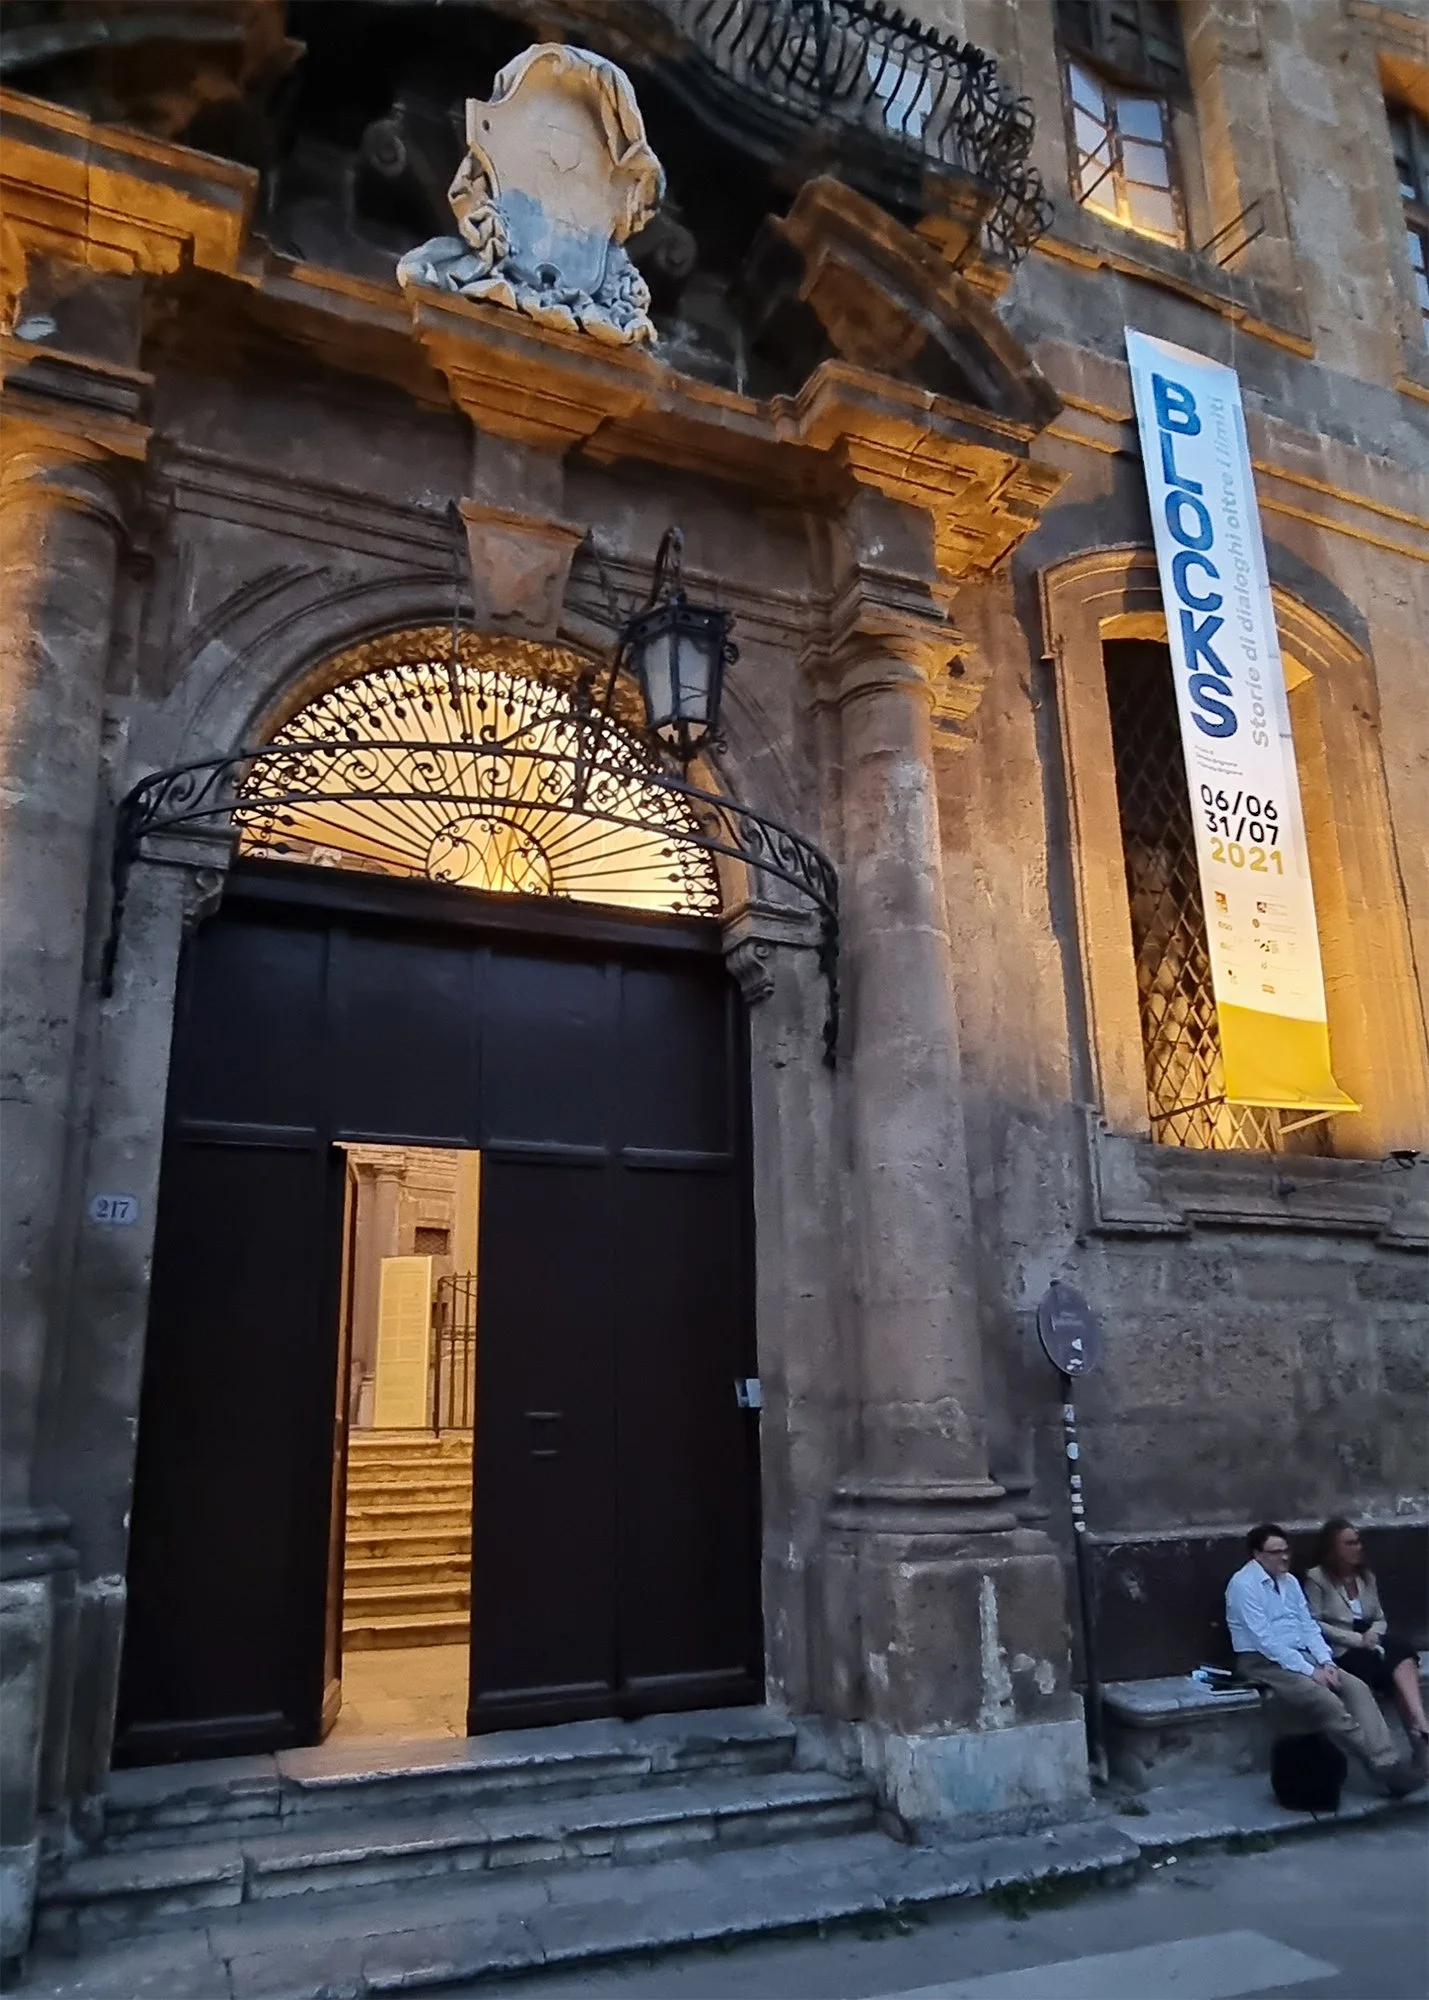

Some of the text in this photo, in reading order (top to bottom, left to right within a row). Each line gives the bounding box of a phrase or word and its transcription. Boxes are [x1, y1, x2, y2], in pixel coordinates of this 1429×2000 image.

[1152, 373, 1238, 738] BLOCKS
[1209, 395, 1269, 748] Storie di dialoghi oltre i limiti
[1201, 784, 1278, 820] 06/06
[1204, 809, 1279, 845] 31/07
[1210, 837, 1283, 875] 2021
[97, 1199, 129, 1218] 217
